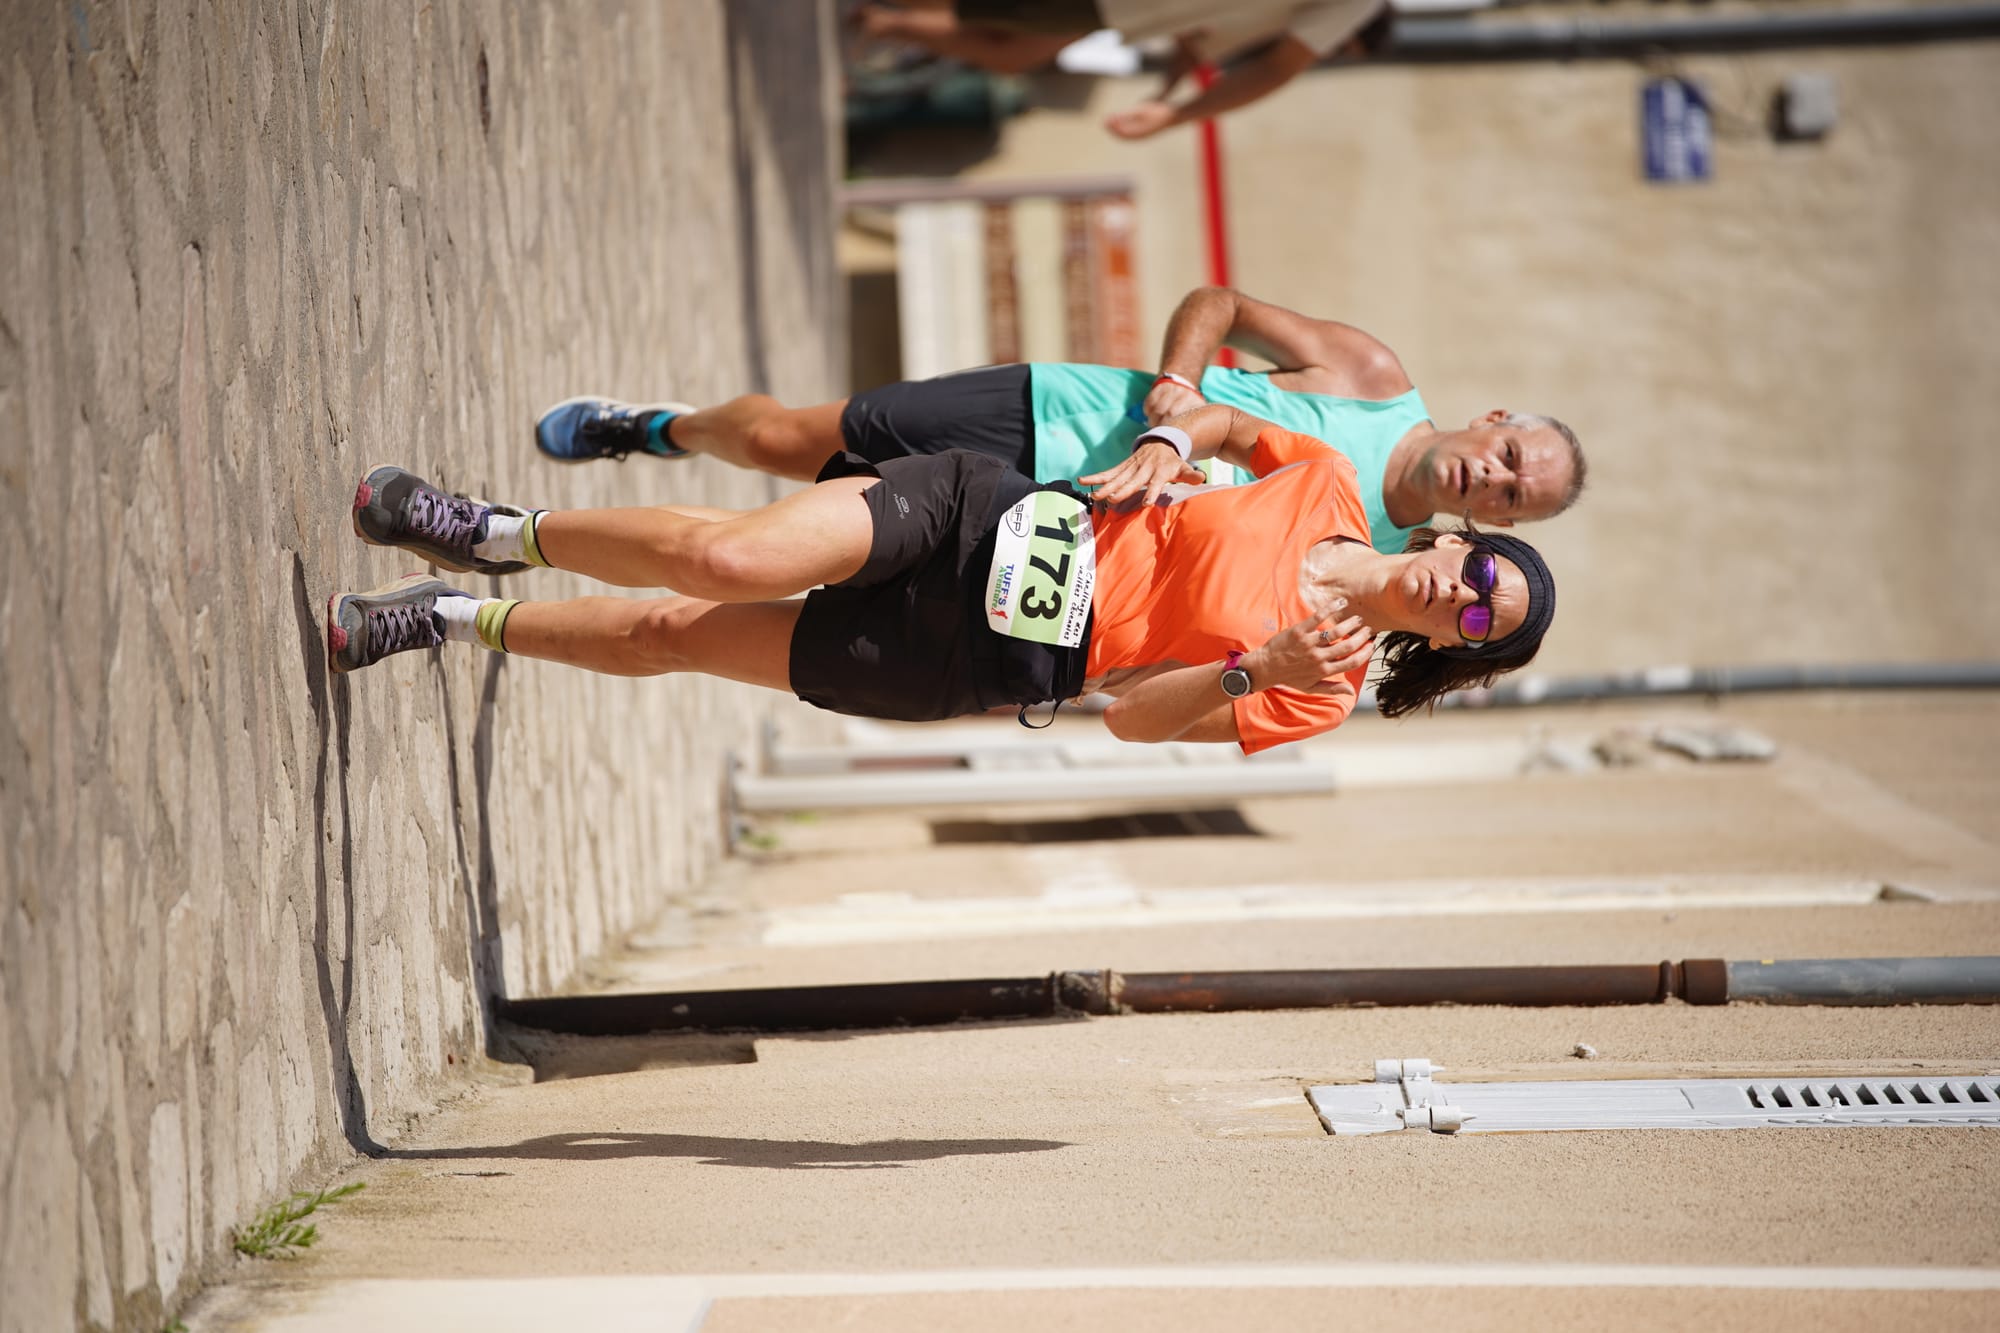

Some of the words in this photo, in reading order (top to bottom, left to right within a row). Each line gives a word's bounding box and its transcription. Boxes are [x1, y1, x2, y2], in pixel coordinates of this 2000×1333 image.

[1013, 504, 1024, 532] BFP
[992, 566, 1006, 608] Aventure
[998, 564, 1014, 606] TUFF'S
[1020, 518, 1074, 620] 173
[1078, 572, 1092, 616] Challenge
[1073, 622, 1081, 636] des
